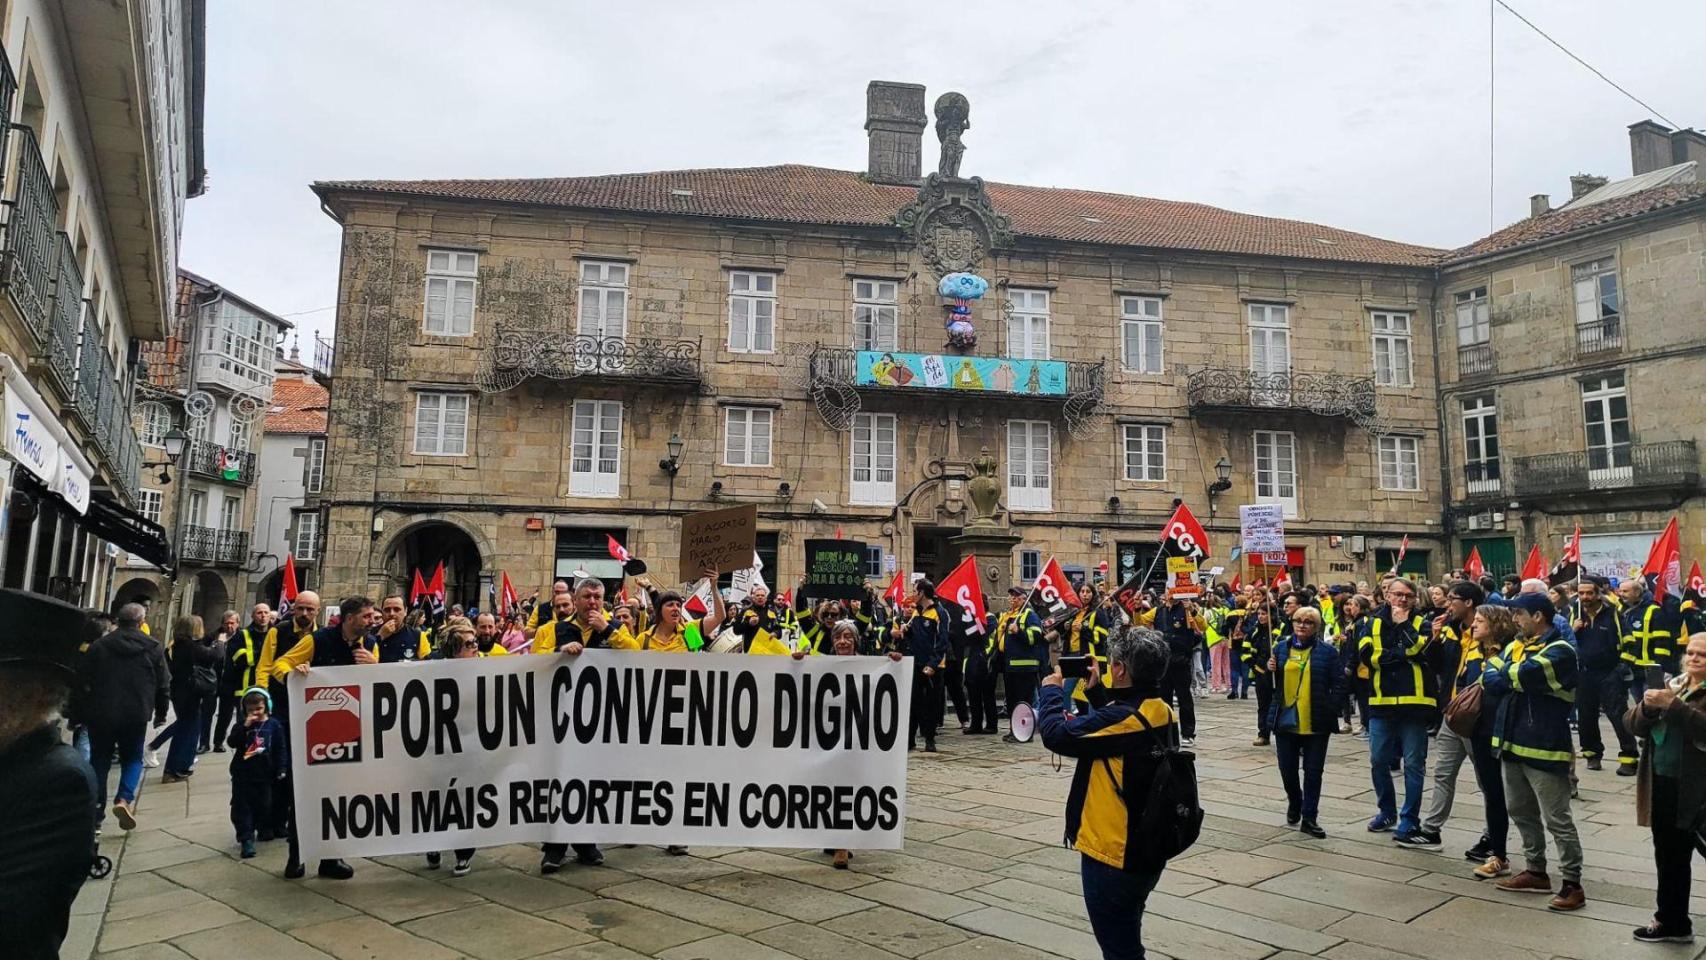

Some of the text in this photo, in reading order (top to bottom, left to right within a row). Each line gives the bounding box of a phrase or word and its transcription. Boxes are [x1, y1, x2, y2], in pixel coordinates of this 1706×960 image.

[1169, 521, 1203, 558] CGT
[1329, 562, 1354, 572] FROIZ
[373, 666, 898, 758] POR UN CONVENIO DIGNO
[311, 741, 358, 761] CGT
[322, 778, 898, 840] NON MÁIS RECORTES EN CORREOS
